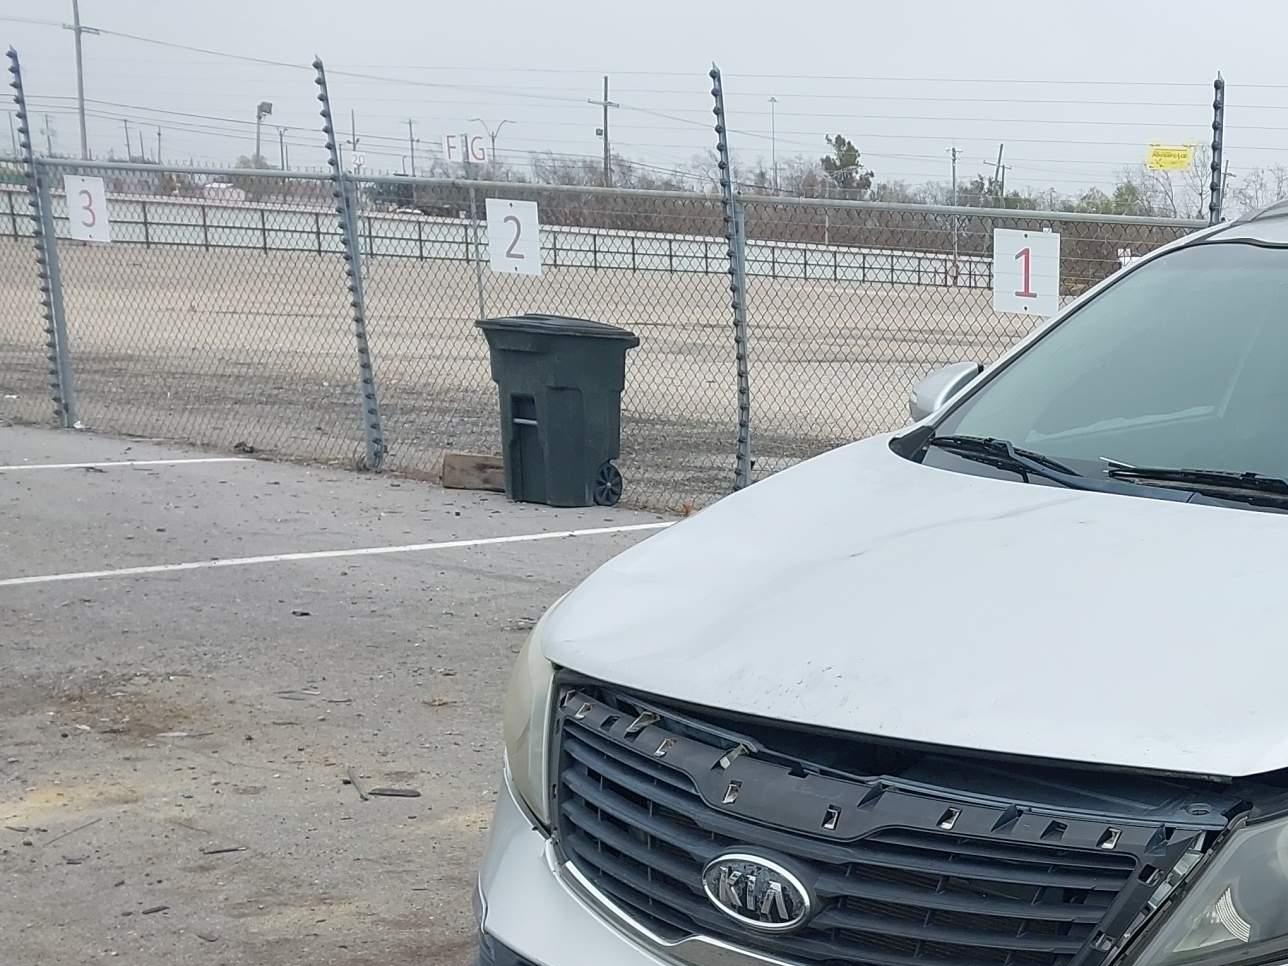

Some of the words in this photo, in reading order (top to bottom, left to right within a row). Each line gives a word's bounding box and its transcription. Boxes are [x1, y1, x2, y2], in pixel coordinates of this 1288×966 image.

[79, 189, 96, 228] 3
[503, 215, 525, 260] 2
[1014, 247, 1038, 299] 1
[718, 865, 789, 921] KIA
